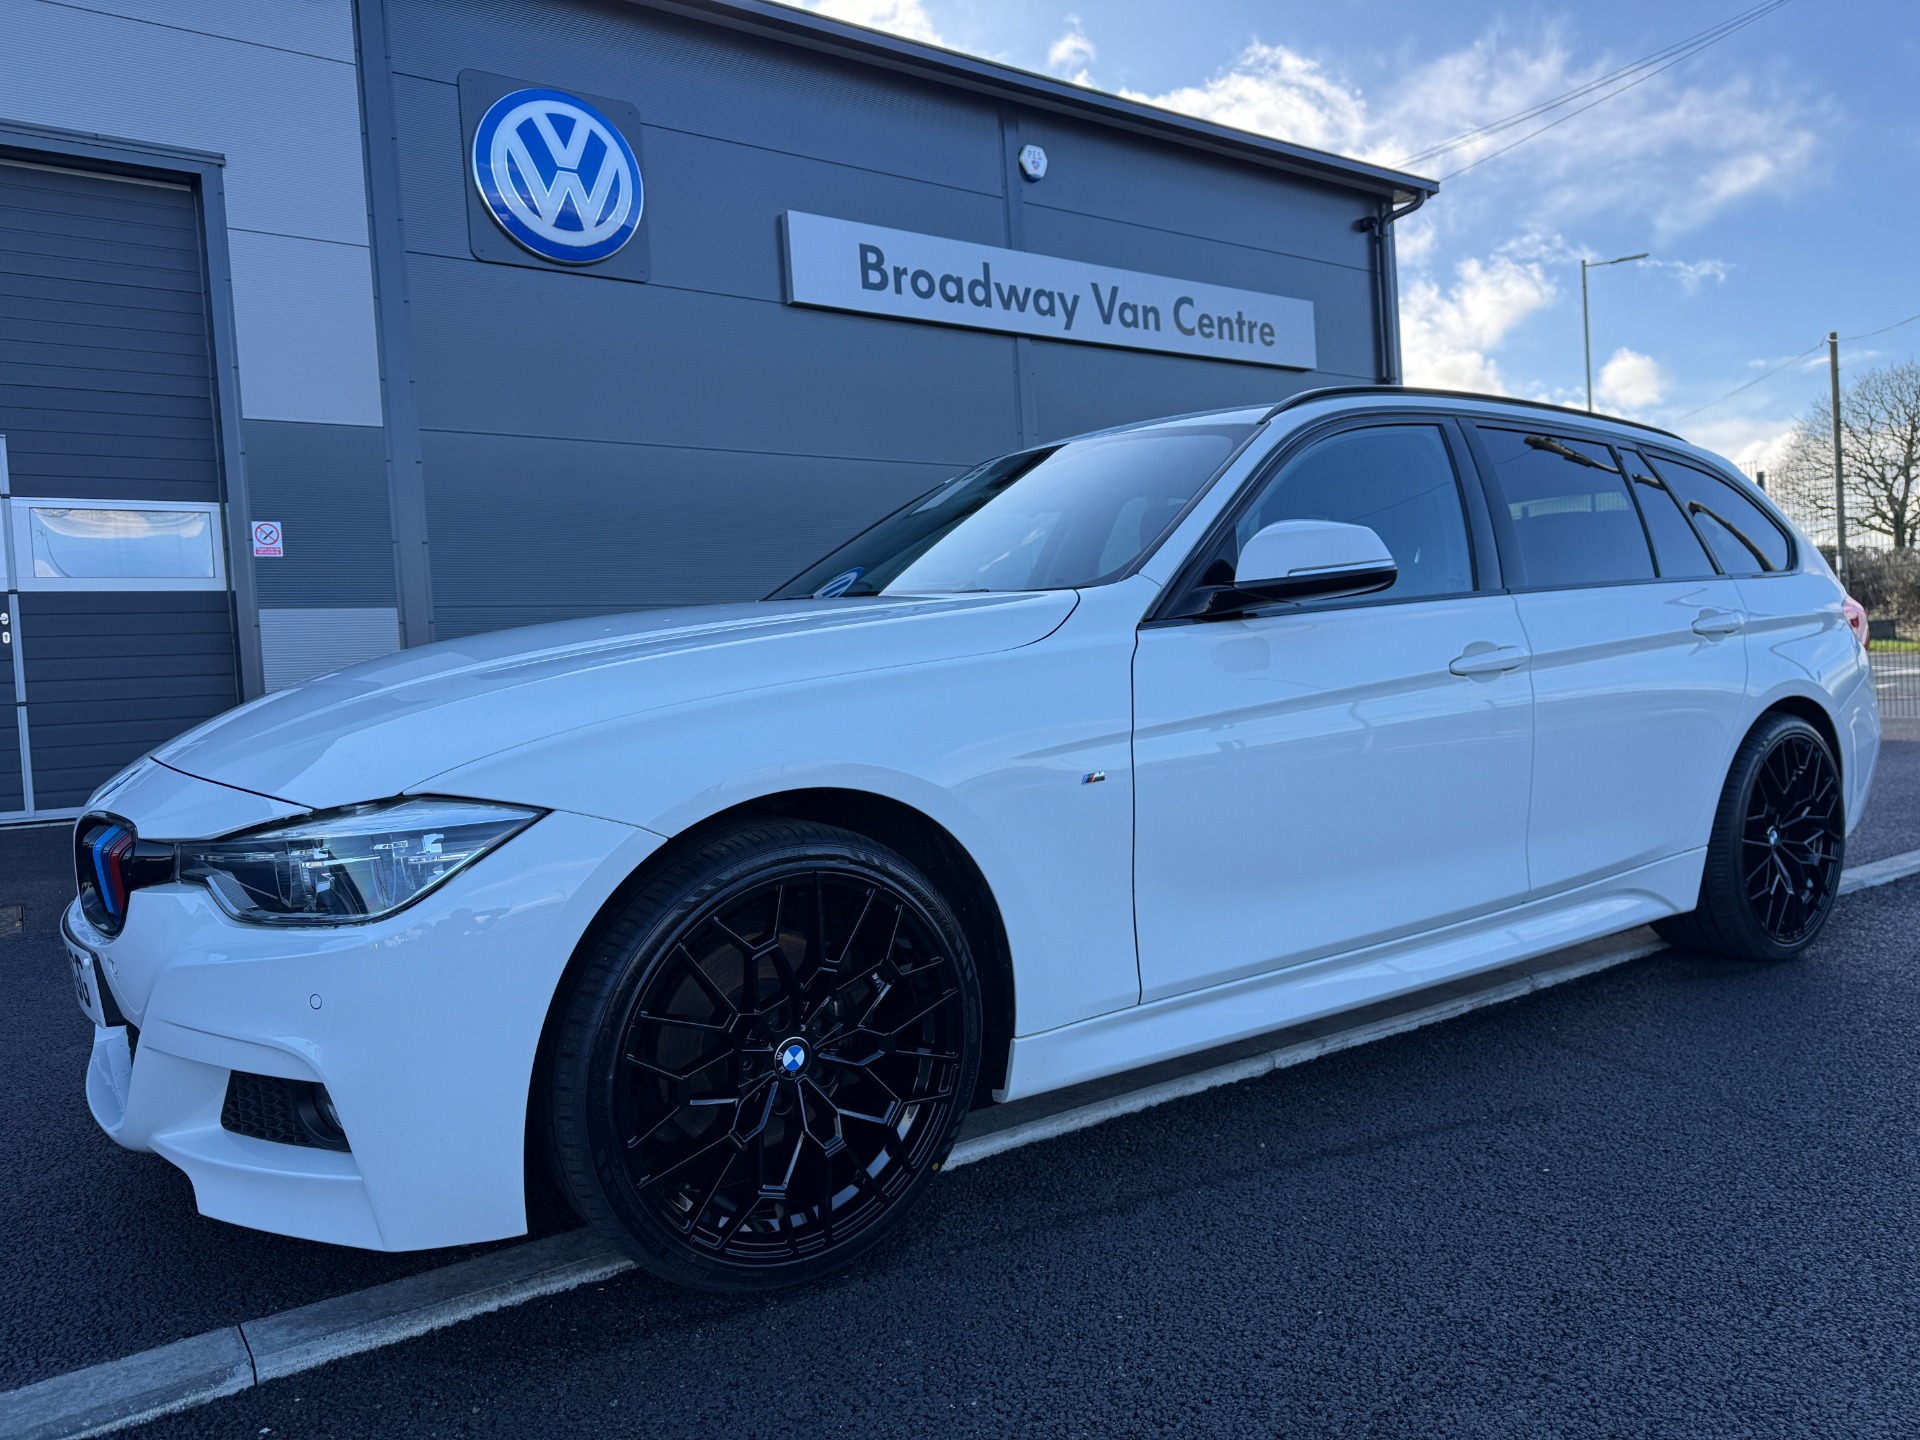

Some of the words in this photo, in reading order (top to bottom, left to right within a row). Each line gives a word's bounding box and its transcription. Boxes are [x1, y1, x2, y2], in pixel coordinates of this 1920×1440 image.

[859, 243, 1080, 331] Broadway
[1090, 282, 1161, 332] Van
[1173, 296, 1275, 347] Centre
